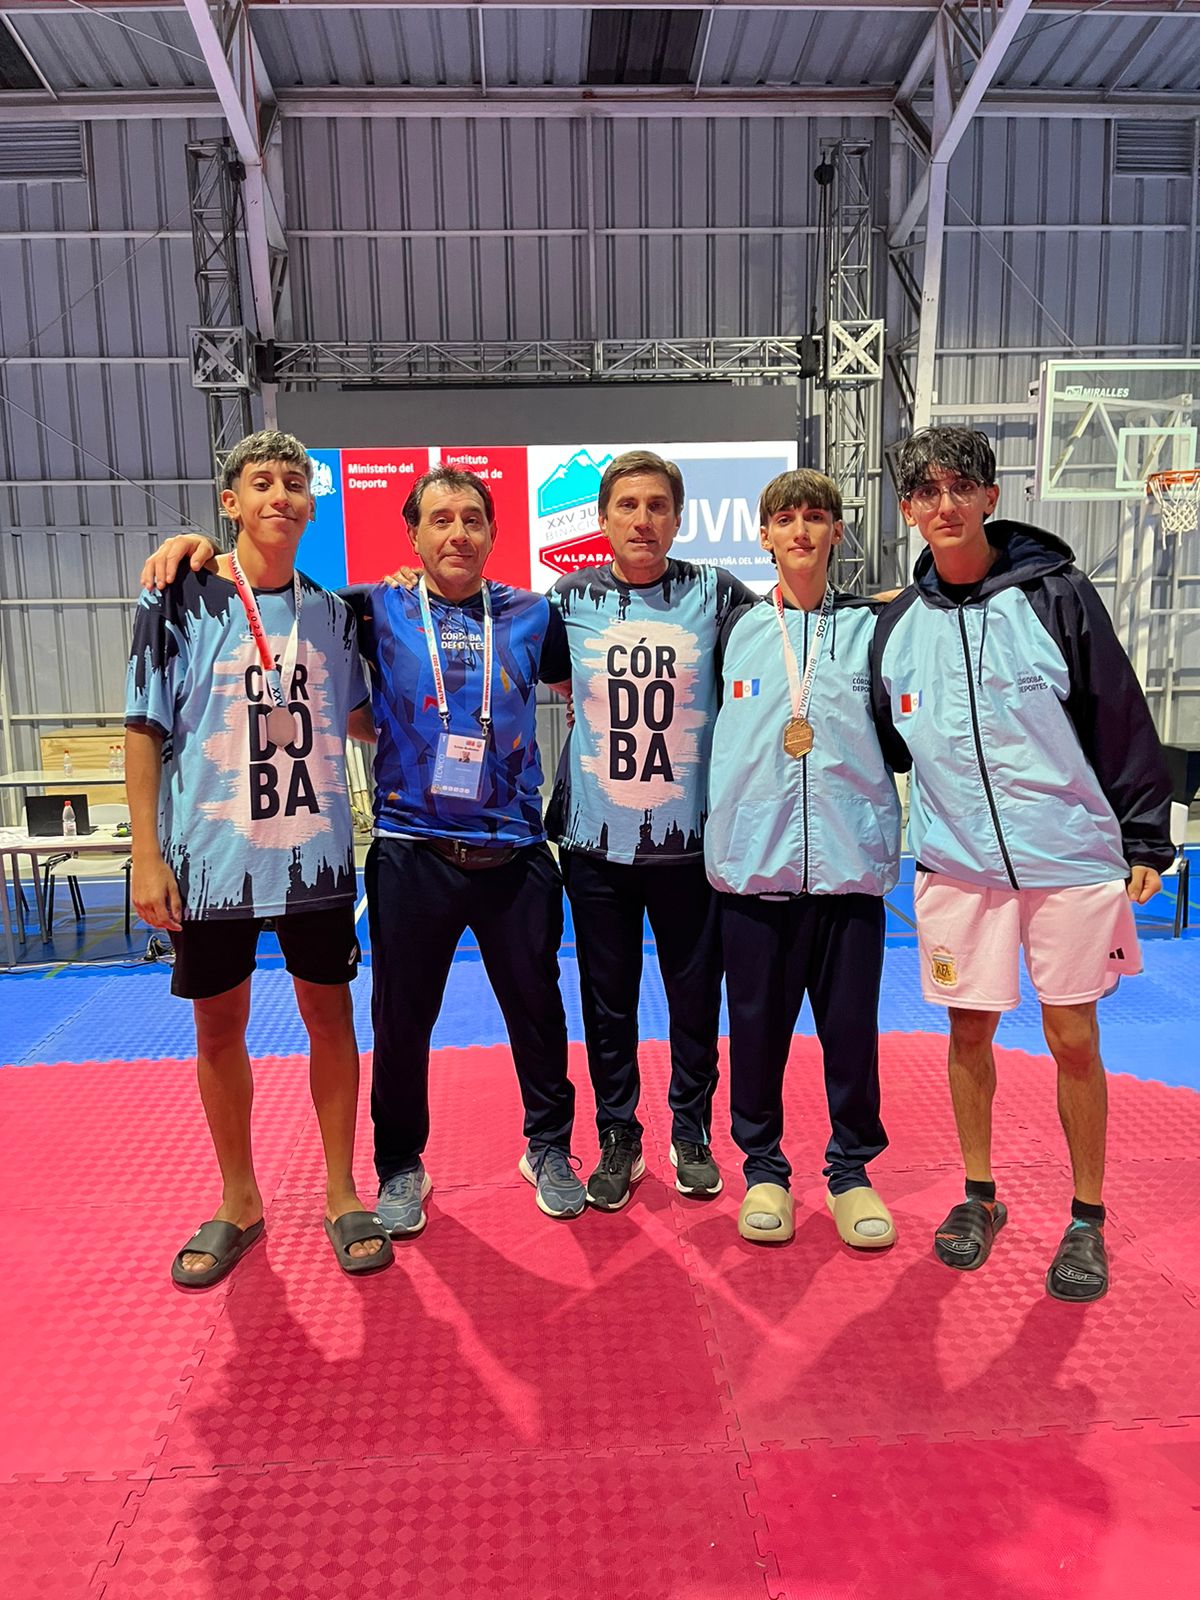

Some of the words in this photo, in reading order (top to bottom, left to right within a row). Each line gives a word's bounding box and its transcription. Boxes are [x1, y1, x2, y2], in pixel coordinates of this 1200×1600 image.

[1082, 388, 1130, 398] MIRALLES
[348, 463, 397, 474] Ministerio
[399, 463, 414, 473] del
[446, 454, 489, 464] Instituto
[349, 478, 388, 490] Deporte
[490, 468, 503, 479] de
[547, 512, 575, 530] XXV
[580, 505, 598, 520] JU
[673, 498, 761, 542] UVM
[553, 553, 613, 563] VALPARA
[739, 557, 753, 566] DEL
[247, 607, 263, 638] 2023
[607, 637, 677, 679] CÓR
[797, 657, 818, 719] BINACIONALE
[608, 678, 675, 732] DO
[247, 702, 314, 763] DO
[610, 730, 675, 782] BA
[249, 760, 321, 821] BA
